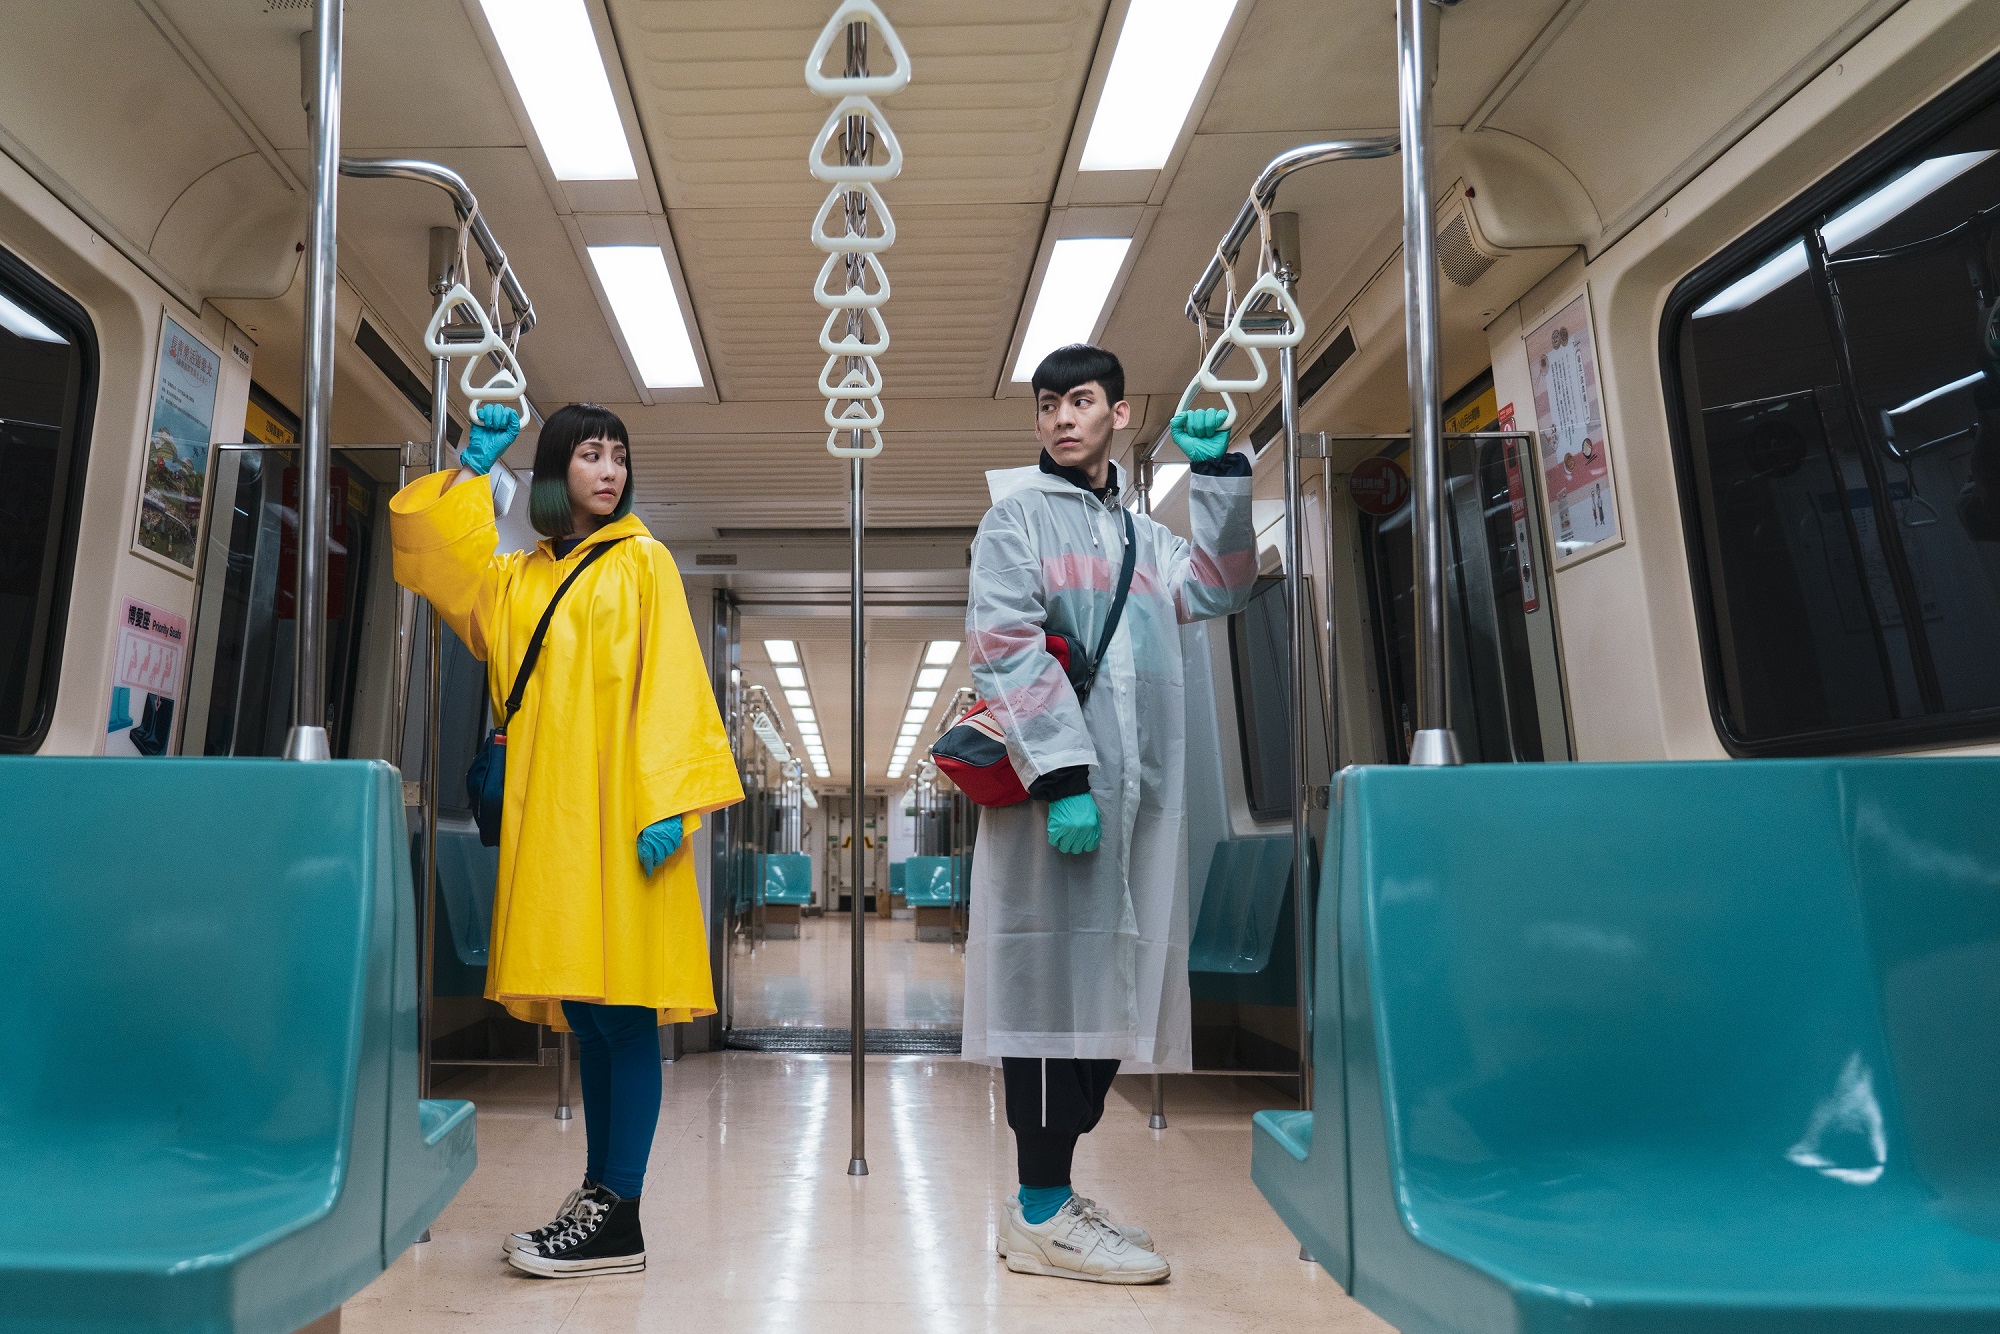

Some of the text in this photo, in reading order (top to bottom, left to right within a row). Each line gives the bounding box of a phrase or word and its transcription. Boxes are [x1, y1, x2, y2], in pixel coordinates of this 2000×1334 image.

[128, 604, 151, 630] 博愛座
[152, 620, 182, 640] Priority Seats
[1052, 1240, 1075, 1252] Reebok
